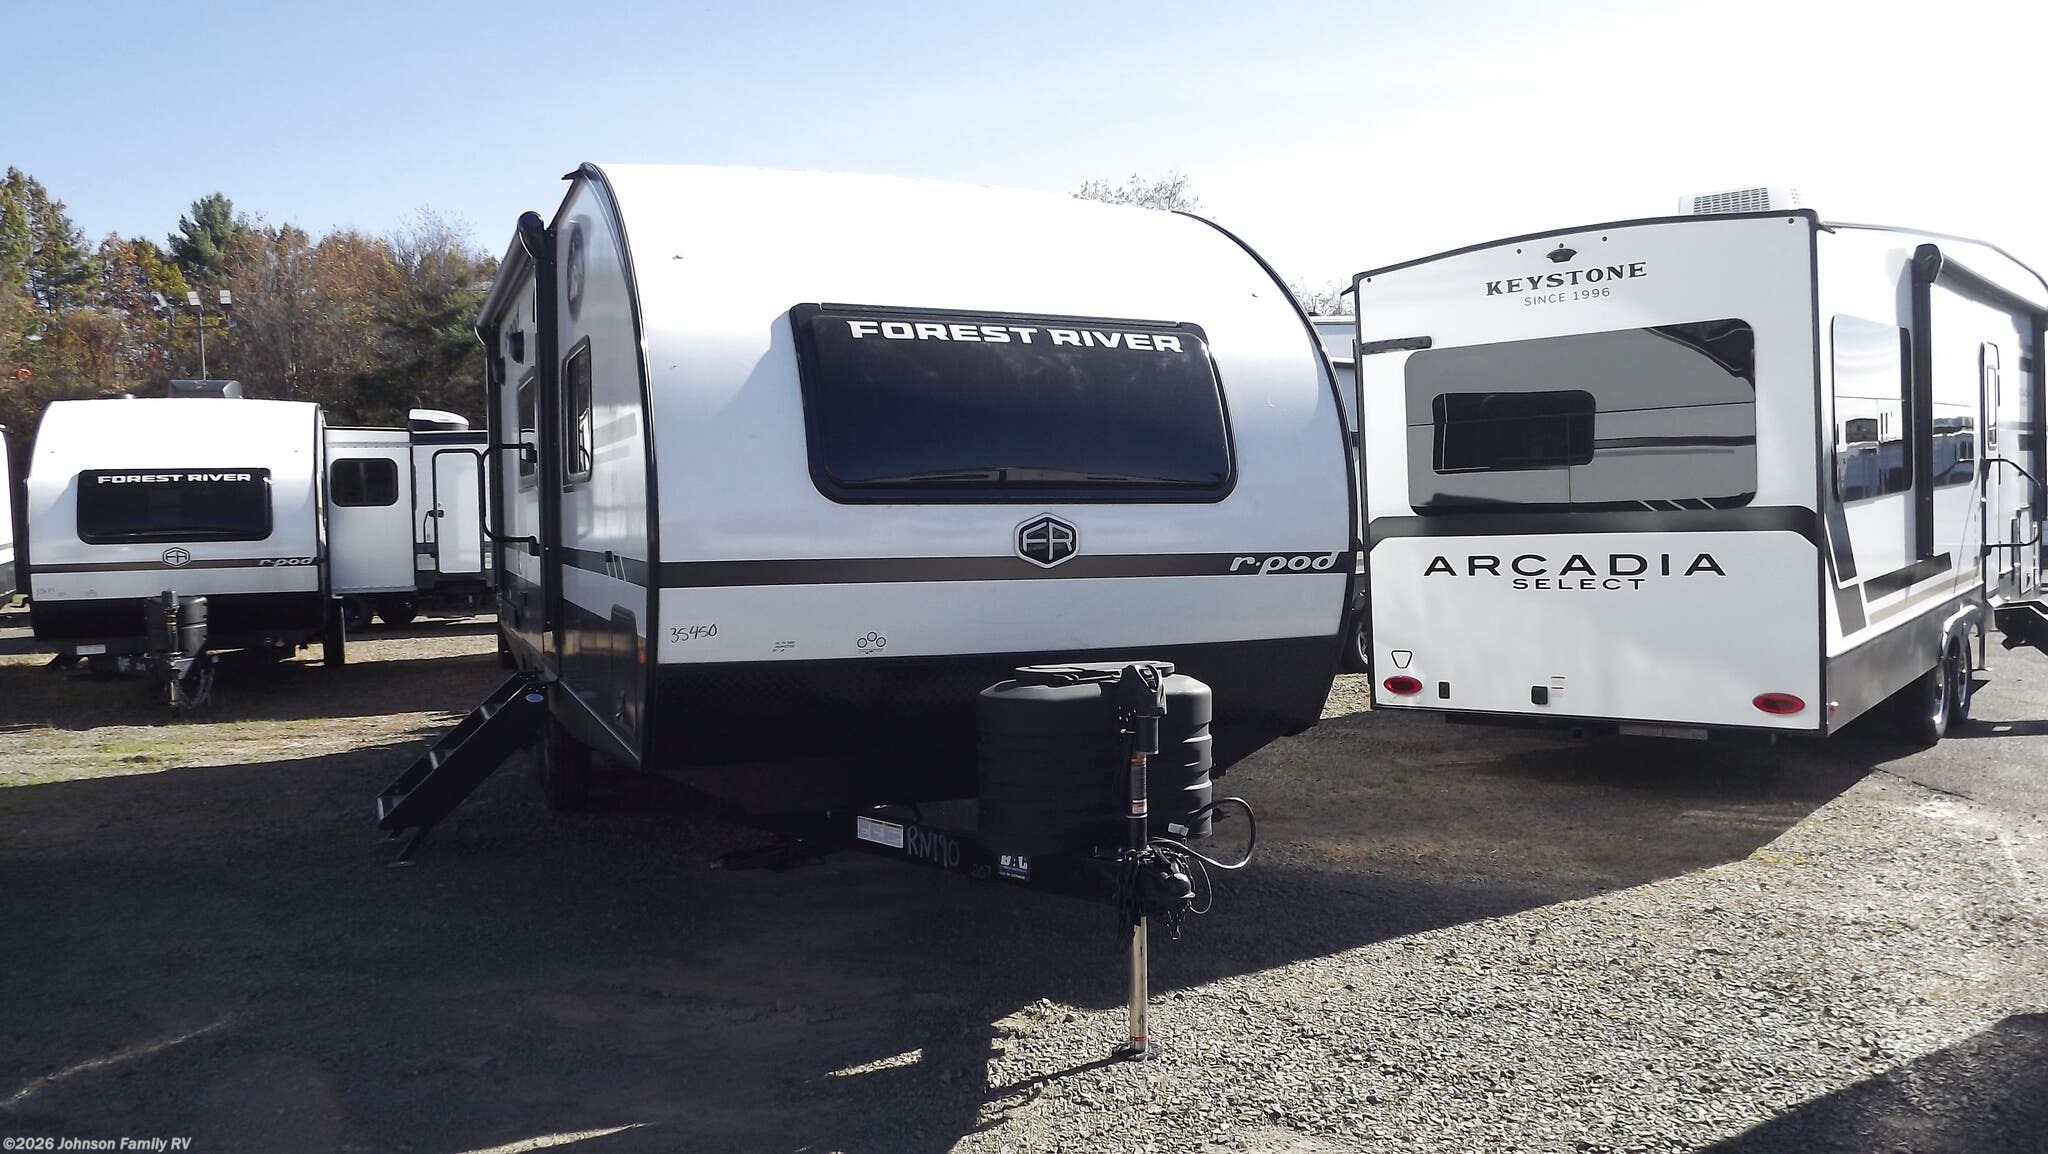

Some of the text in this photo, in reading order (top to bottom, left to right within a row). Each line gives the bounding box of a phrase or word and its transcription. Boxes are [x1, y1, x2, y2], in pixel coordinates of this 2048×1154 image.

[1486, 262, 1647, 296] KEYSTONE
[1524, 287, 1610, 307] SINCE 1996
[846, 320, 1184, 353] FOREST RIVER
[98, 473, 251, 484] FOREST RIVER
[1423, 553, 1727, 577] ARCADIA
[1512, 578, 1645, 591] SELECT
[670, 623, 718, 644] 35450
[906, 825, 960, 868] RN190
